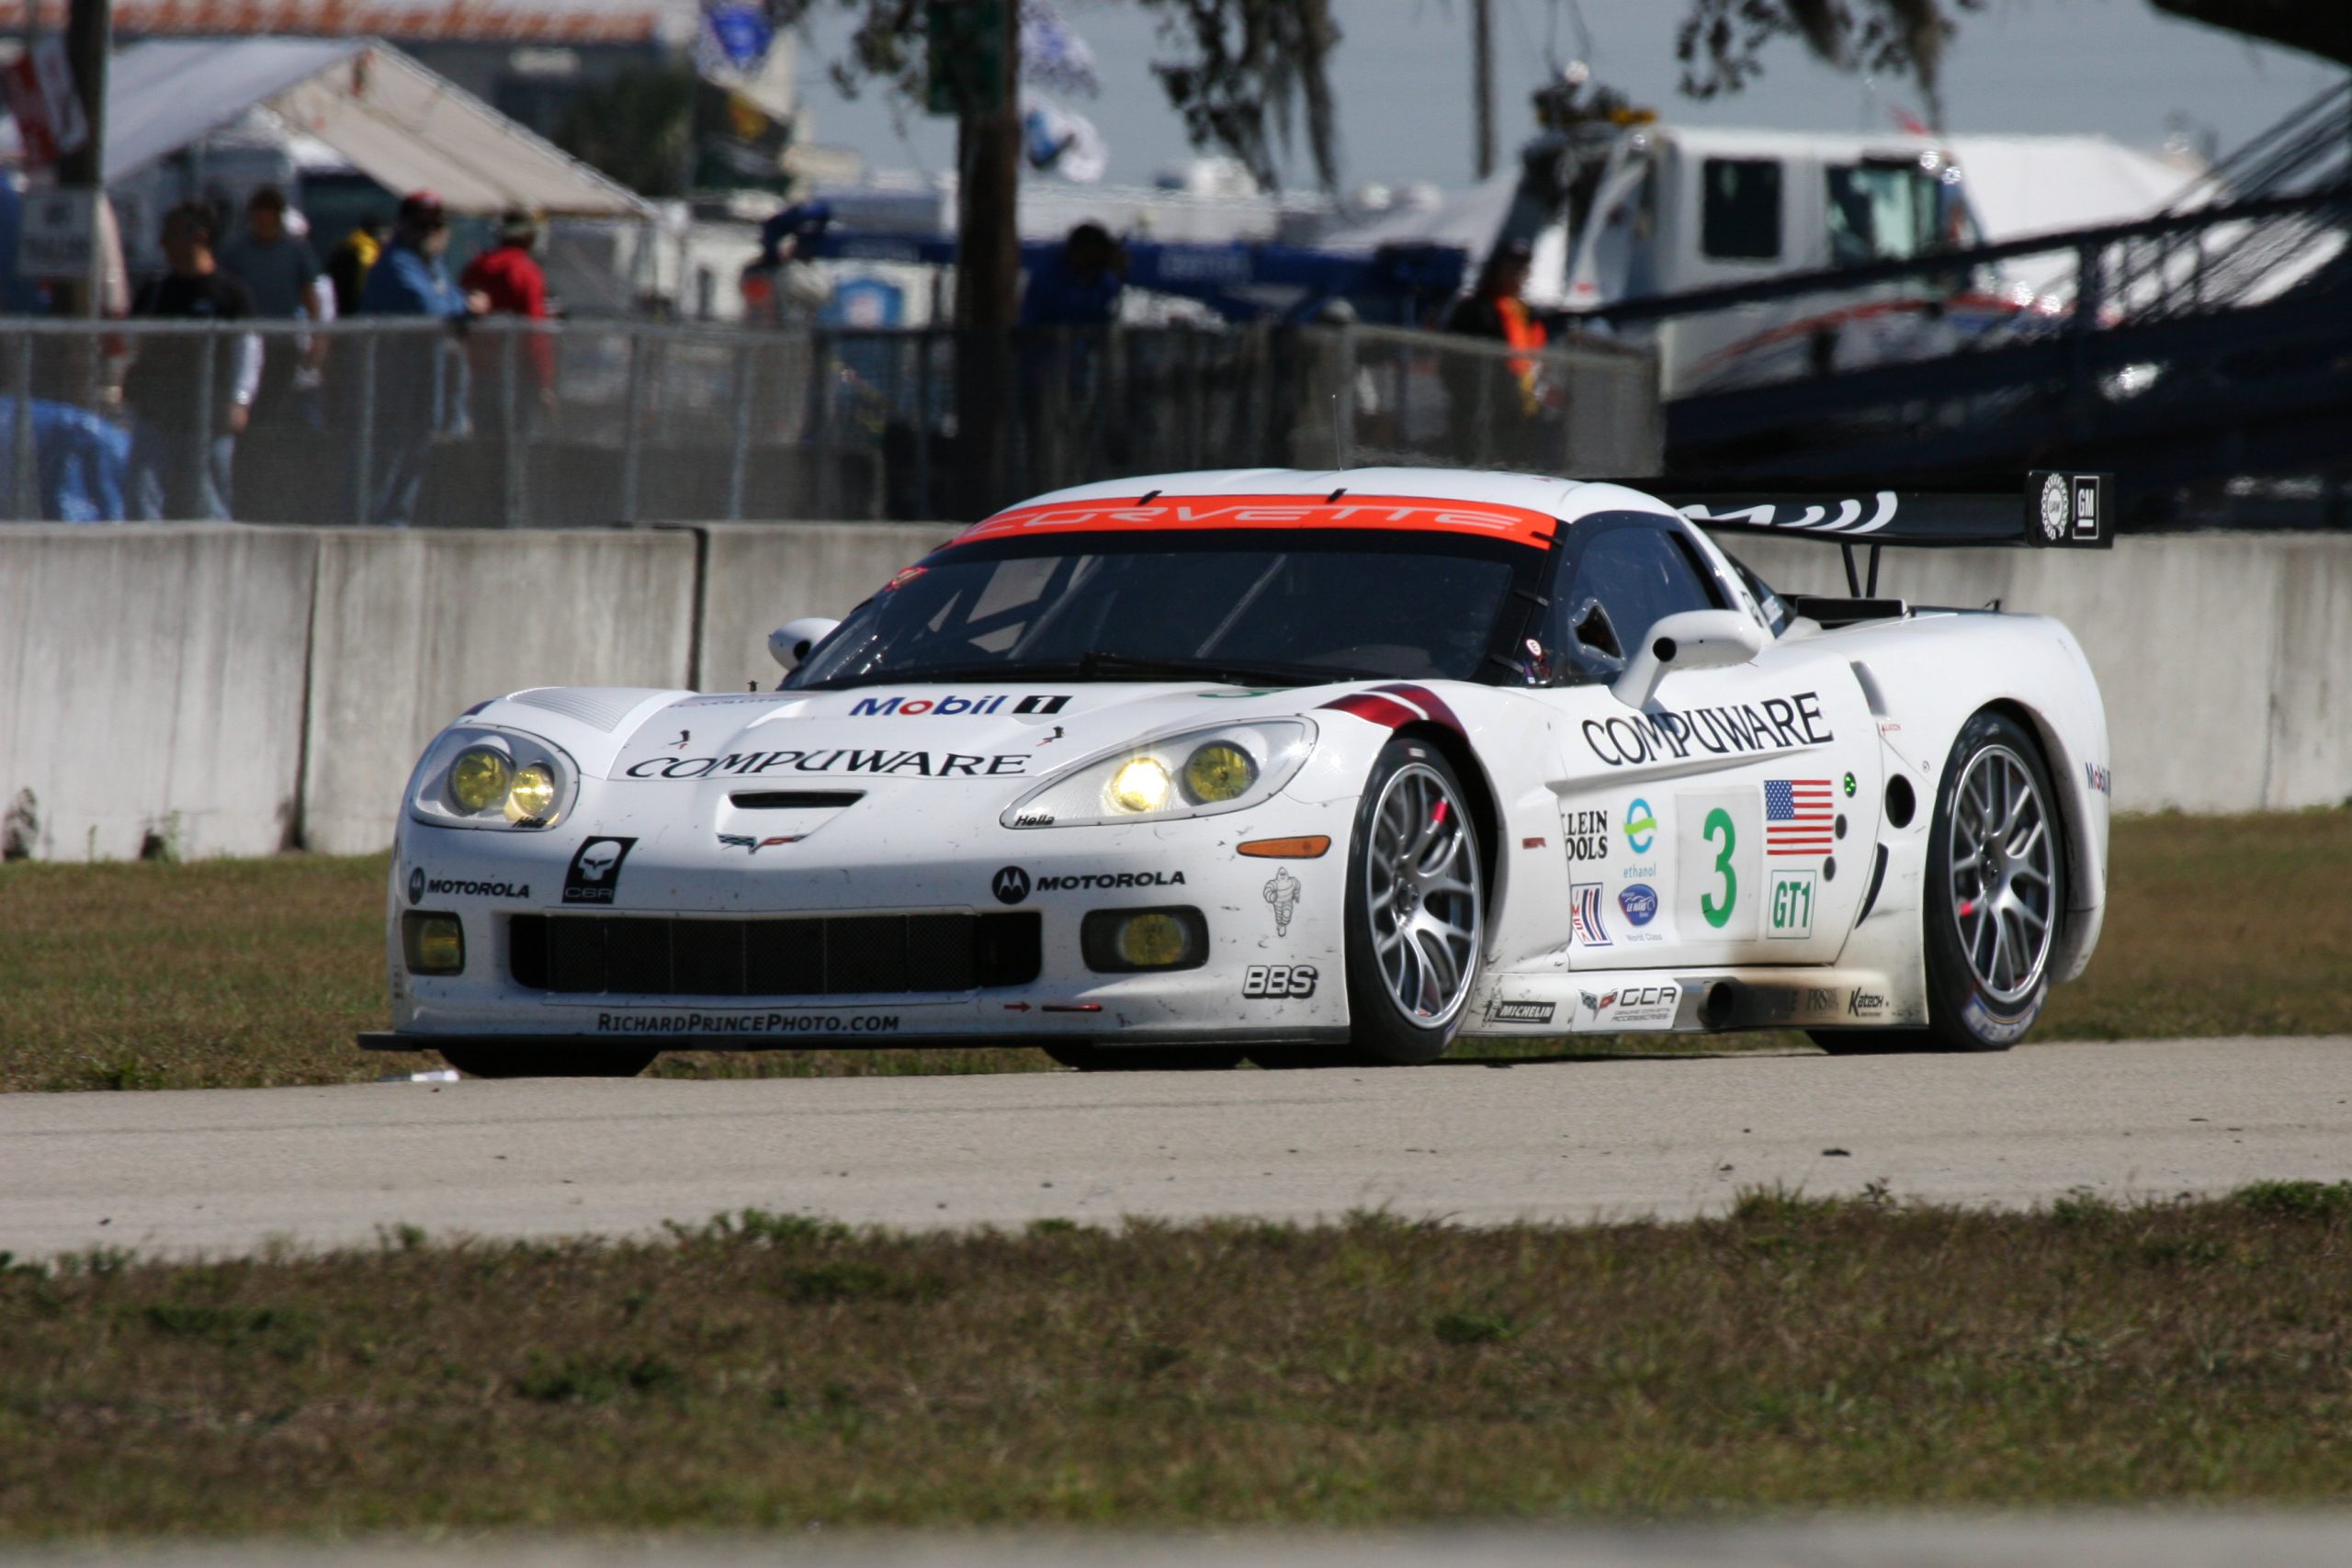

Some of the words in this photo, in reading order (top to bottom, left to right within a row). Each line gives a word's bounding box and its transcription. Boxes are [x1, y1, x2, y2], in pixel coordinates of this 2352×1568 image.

[2077, 489, 2095, 517] GM
[962, 504, 1522, 536] CORVETTE
[848, 695, 1009, 716] Mobil
[1581, 692, 1834, 765] COMPUWARE
[626, 749, 1033, 778] COMPUWARE
[1014, 815, 1055, 827] Hella
[1562, 810, 1608, 836] LEIN
[1036, 871, 1186, 891] MOTOROLA
[1623, 863, 1657, 879] ethanol
[1701, 807, 1737, 929] 3
[426, 879, 530, 898] MOTOROLA
[1773, 881, 1811, 928] GT1
[1242, 964, 1319, 999] BBS
[1498, 1005, 1554, 1018] MICHELIN
